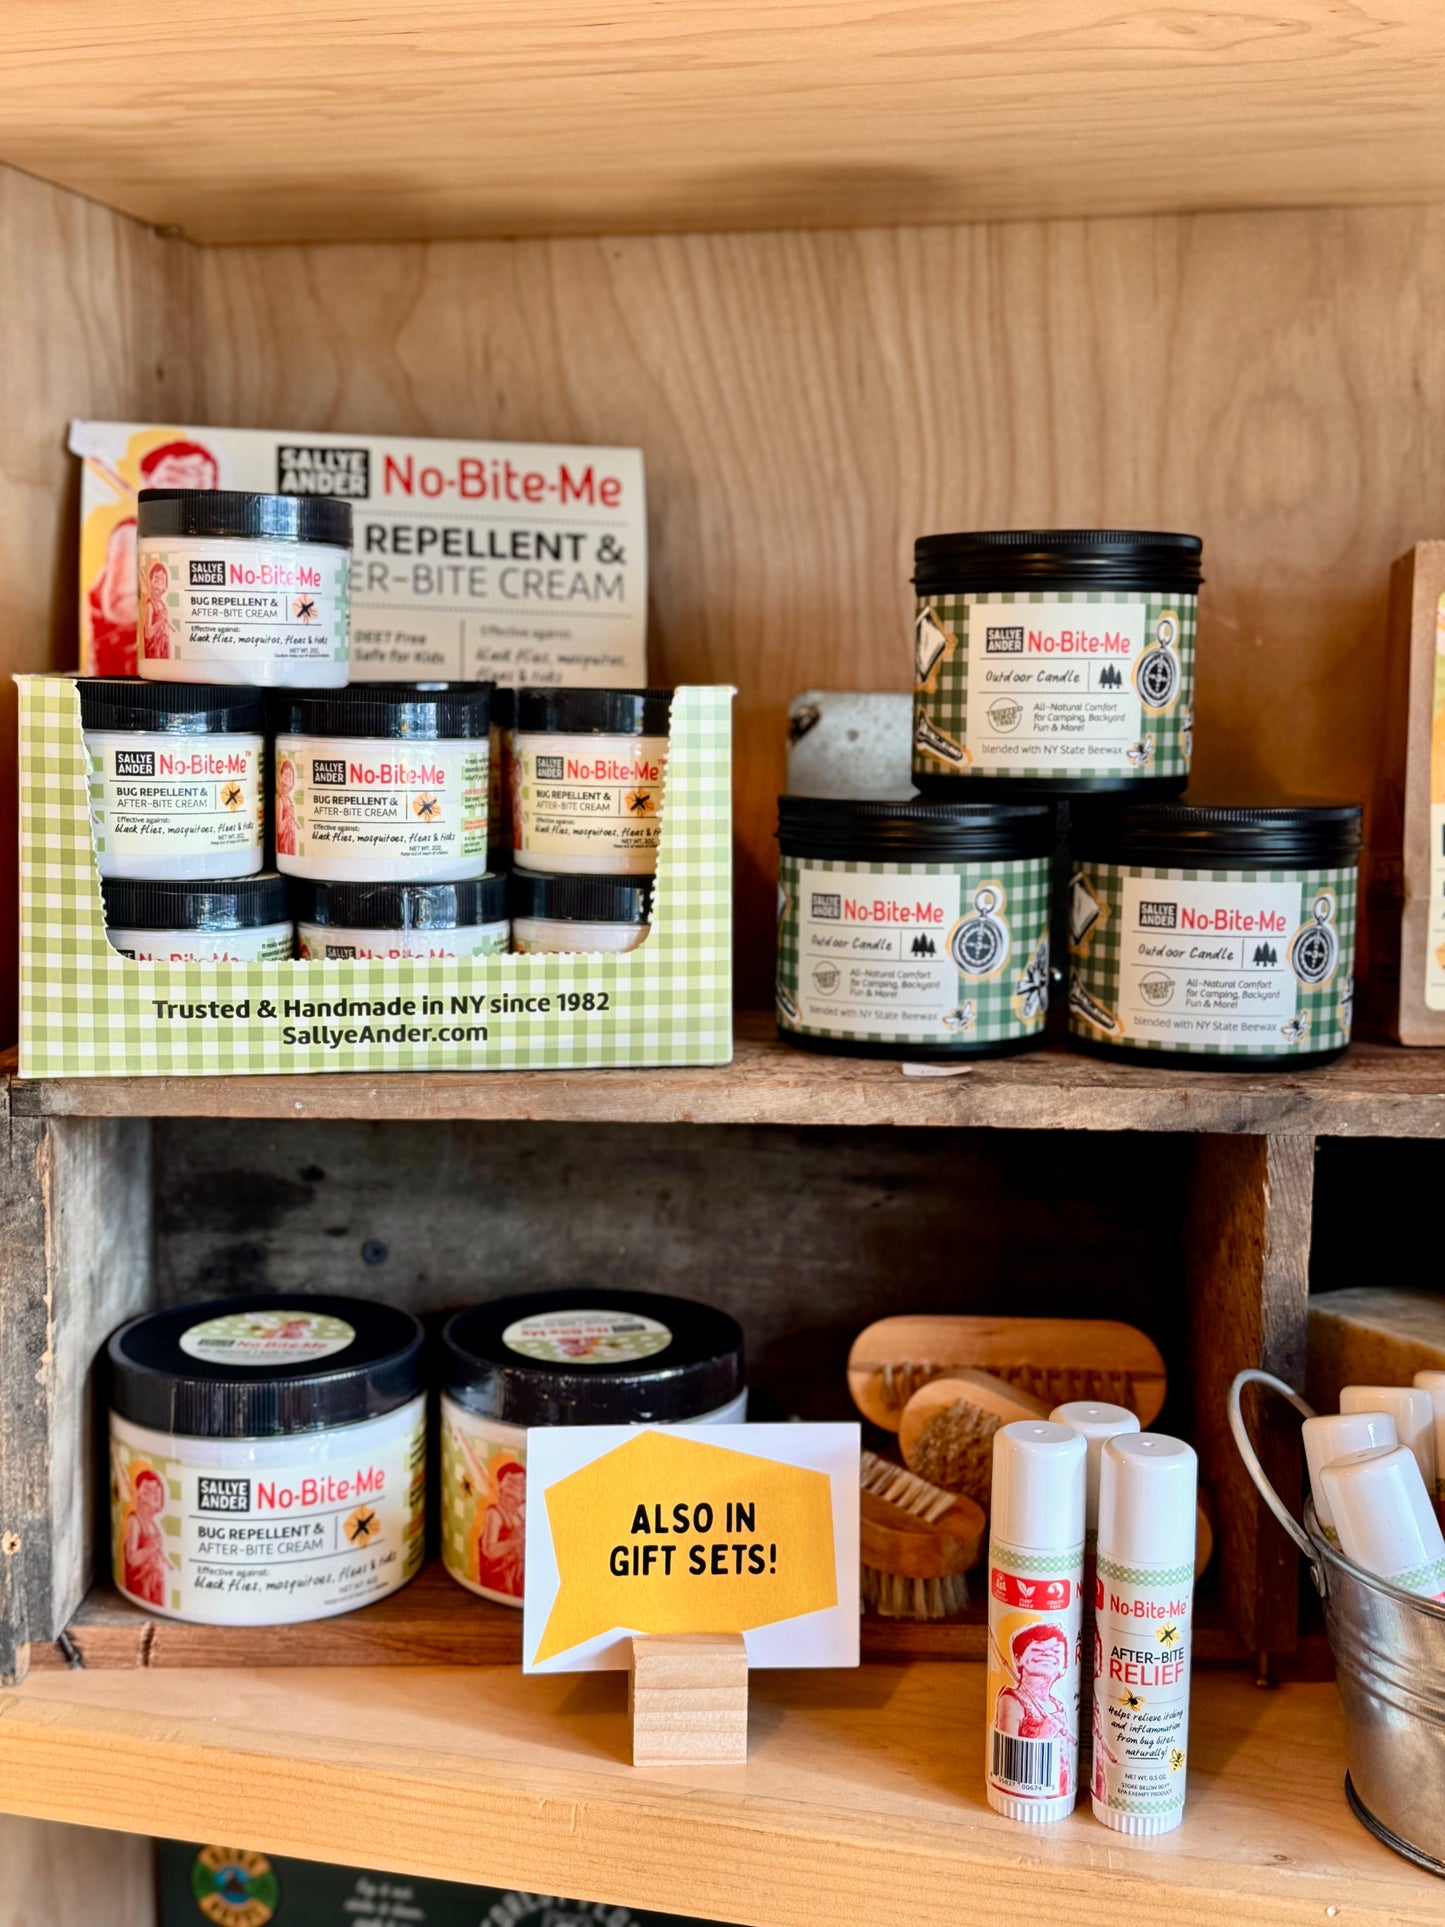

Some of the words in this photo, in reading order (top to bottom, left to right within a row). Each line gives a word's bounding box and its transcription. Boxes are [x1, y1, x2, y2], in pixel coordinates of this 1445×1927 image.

[281, 449, 367, 471] SALLYE
[279, 469, 368, 495] ANDER
[383, 453, 623, 508] No-Bite-Me
[366, 524, 586, 562] REPELLENT
[595, 535, 626, 565] &
[191, 562, 223, 573] SALLYE
[192, 573, 224, 584] ANDER
[230, 564, 321, 587] No-Bite-Me
[347, 561, 486, 597] ER-BITE
[499, 567, 626, 602] CREAM
[191, 597, 210, 606] BUG
[211, 597, 268, 607] REPELLENT
[270, 599, 278, 607] &
[191, 608, 243, 617] AFTER-BITE
[245, 609, 278, 619] CREAM
[988, 628, 1022, 640] SALLYE
[988, 640, 1022, 652] ANDER
[1028, 630, 1131, 654] No-Bite-Me
[986, 669, 1033, 682] Outdoor
[1036, 669, 1081, 683] Candle
[1033, 703, 1083, 712] All-Natural
[1084, 703, 1118, 712] Comfort
[1034, 714, 1045, 722] for
[1088, 713, 1125, 723] Backyard
[982, 744, 1018, 754] blended
[1021, 744, 1041, 754] with
[1043, 745, 1057, 754] NY
[1060, 745, 1085, 754] State
[118, 754, 152, 764] SALLYE
[160, 754, 246, 775] No-Bite-Me
[118, 764, 153, 774] ANDER
[314, 762, 344, 773] SALLYE
[350, 763, 445, 785] No-Bite-Me
[568, 759, 659, 781] No-Bite-Me
[315, 772, 344, 783] ANDER
[117, 787, 137, 796] BUG
[140, 788, 198, 796] REPELLENT
[537, 790, 550, 798] BUG
[552, 790, 602, 800] REPELLENT
[603, 792, 611, 801] &
[117, 799, 173, 808] AFTER-BITE
[175, 799, 208, 808] CREAM
[313, 795, 331, 804] BUG
[332, 796, 388, 805] REPELLENT
[390, 797, 398, 806] &
[537, 801, 578, 810] AFTER-BITE
[579, 802, 610, 811] CREAM
[314, 807, 363, 817] AFTER-BITE
[364, 807, 397, 817] CREAM
[115, 824, 138, 834] black
[140, 825, 165, 835] flies,
[312, 831, 330, 840] black
[332, 832, 355, 843] flies,
[844, 899, 944, 923] No-Bite-Me
[1141, 904, 1176, 916] SALLYE
[1140, 915, 1175, 927] ANDER
[1181, 908, 1286, 932] No-Bite-Me
[852, 937, 893, 951] Candle
[1138, 943, 1185, 957] Outdoor
[1190, 947, 1234, 961] Candle
[1186, 979, 1236, 988] All-Natural
[1238, 980, 1272, 989] Comfort
[1186, 989, 1198, 998] for
[1242, 991, 1280, 1001] Backyard
[152, 999, 250, 1020] Trusted
[256, 999, 278, 1019] &
[284, 995, 415, 1019] Handmade
[422, 995, 444, 1015] in
[450, 994, 486, 1015] NY
[490, 993, 551, 1015] since
[556, 992, 611, 1012] 1982
[1134, 1016, 1171, 1028] blended
[1174, 1018, 1193, 1029] with
[1196, 1022, 1210, 1031] NY
[1213, 1022, 1238, 1031] State
[283, 1022, 489, 1049] SallyeAnder.com
[201, 1480, 247, 1496] SALLYE
[257, 1466, 385, 1510] No-Bite-Me
[200, 1495, 248, 1510] ANDER
[630, 1502, 714, 1534] ALSO
[726, 1502, 756, 1533] IN
[198, 1526, 225, 1539] BUG
[229, 1524, 311, 1540] REPELLENT
[313, 1523, 325, 1534] &
[198, 1541, 274, 1556] AFTER-BITE
[277, 1538, 324, 1554] CREAM
[609, 1545, 676, 1577] GIFT
[689, 1543, 777, 1576] SETS!
[194, 1577, 225, 1590] black
[1110, 1594, 1187, 1618] No-Bite-Me
[1110, 1646, 1184, 1664] AFTER-BITE
[1110, 1659, 1184, 1686] RELIEF
[1108, 1706, 1130, 1720] Helps
[1133, 1713, 1162, 1722] relieve
[1163, 1709, 1183, 1720] itching
[1111, 1721, 1127, 1730] and
[1129, 1722, 1180, 1733] inflammation
[1117, 1733, 1137, 1744] from
[1140, 1737, 1154, 1749] bug
[1126, 1746, 1168, 1759] naturally!
